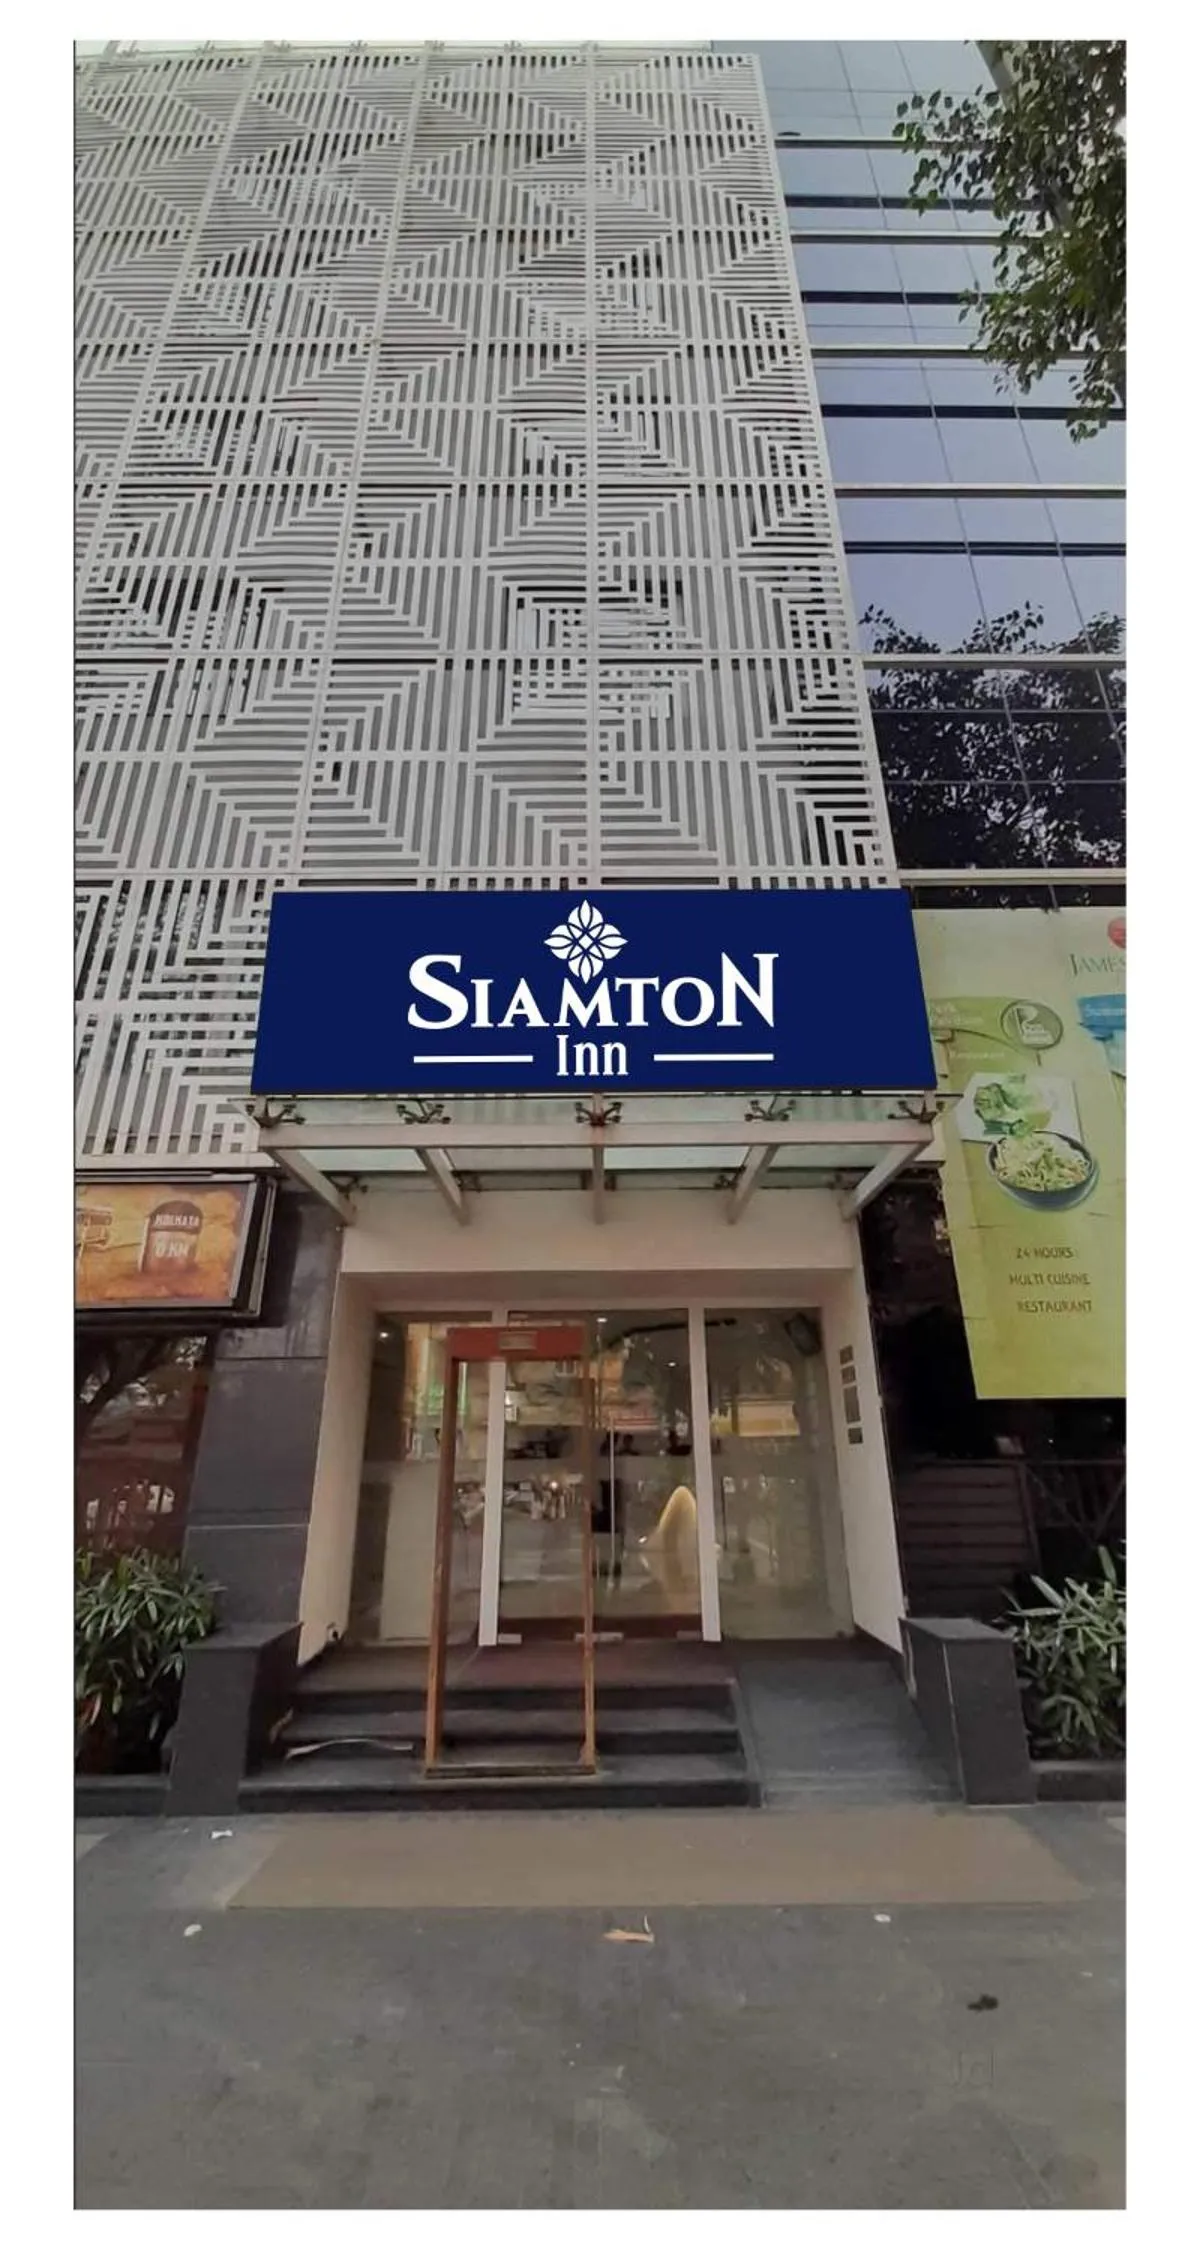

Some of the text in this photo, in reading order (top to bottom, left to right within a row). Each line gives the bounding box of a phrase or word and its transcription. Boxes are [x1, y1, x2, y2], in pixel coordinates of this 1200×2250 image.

[556, 1034, 629, 1076] Inn
[154, 1214, 200, 1227] KOLKATA
[1016, 1246, 1074, 1259] 24 HOURS
[1009, 1272, 1092, 1285] MULTI CUISINE
[1016, 1299, 1093, 1313] RESTAURANT
